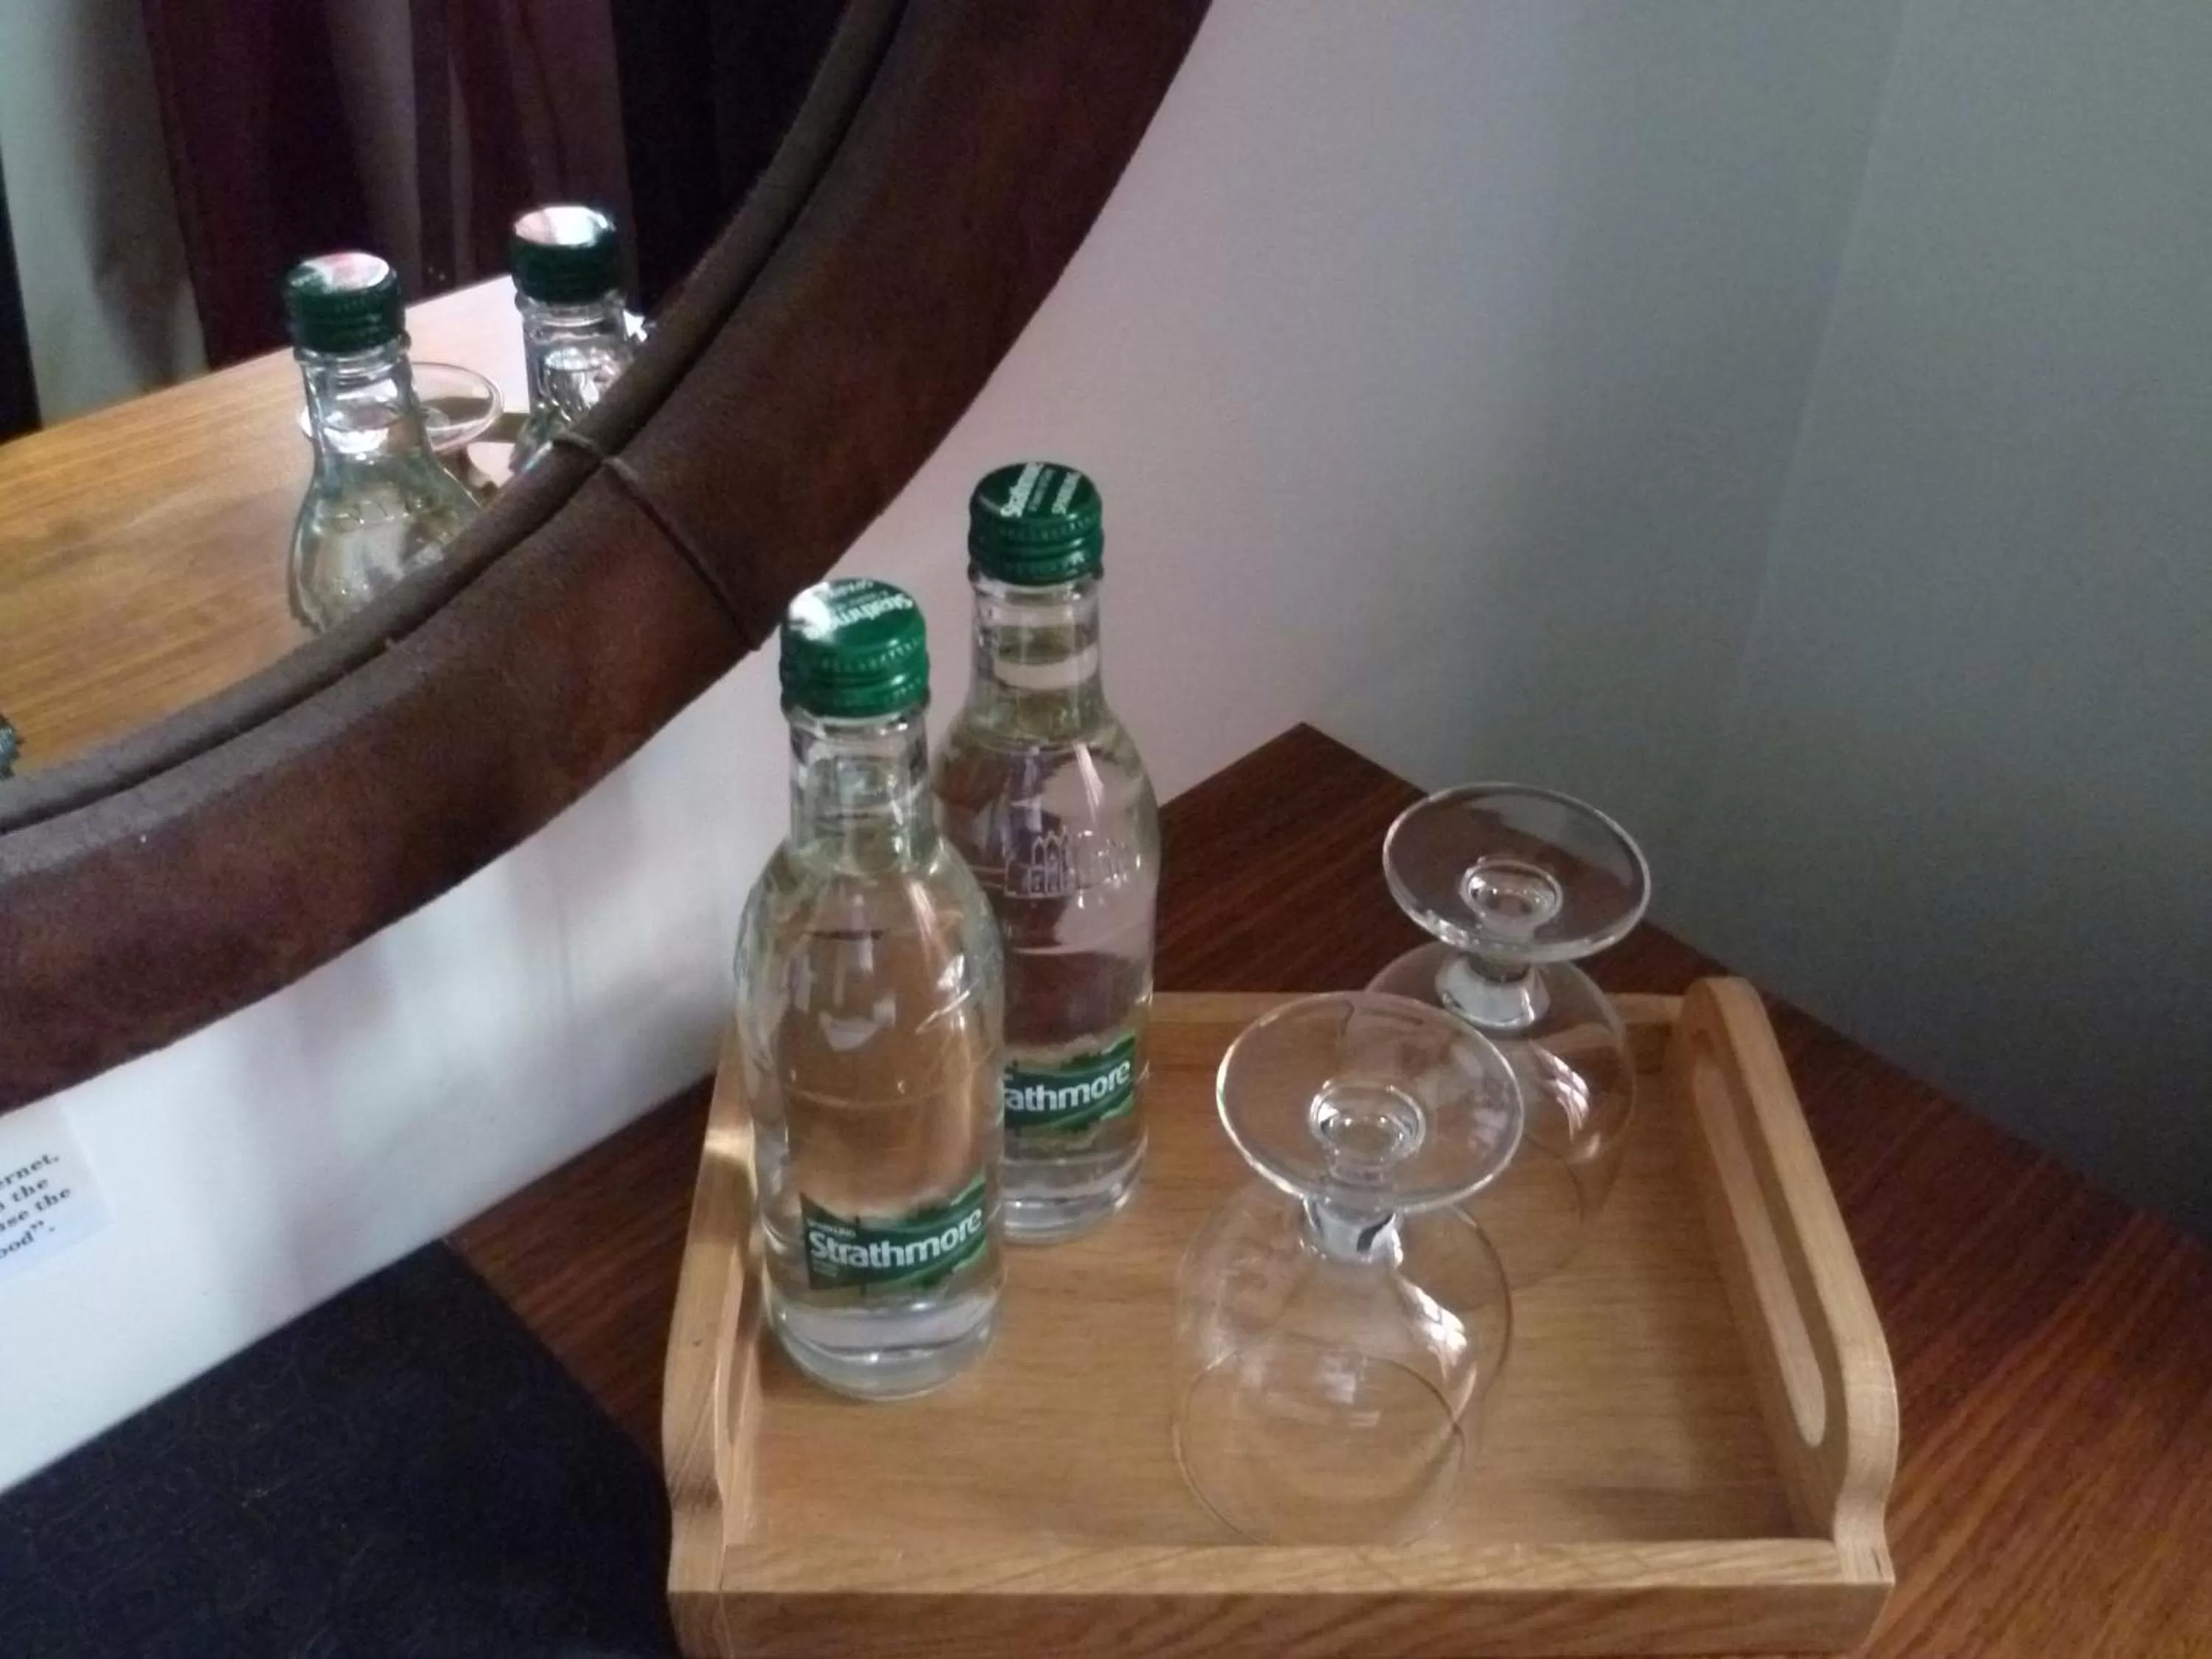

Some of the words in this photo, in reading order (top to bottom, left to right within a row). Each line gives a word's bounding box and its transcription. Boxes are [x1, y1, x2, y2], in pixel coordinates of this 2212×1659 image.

[1004, 1061, 1130, 1112] athmore
[12, 1179, 48, 1203] the
[35, 1188, 72, 1211] the
[808, 1207, 983, 1269] Strathmore
